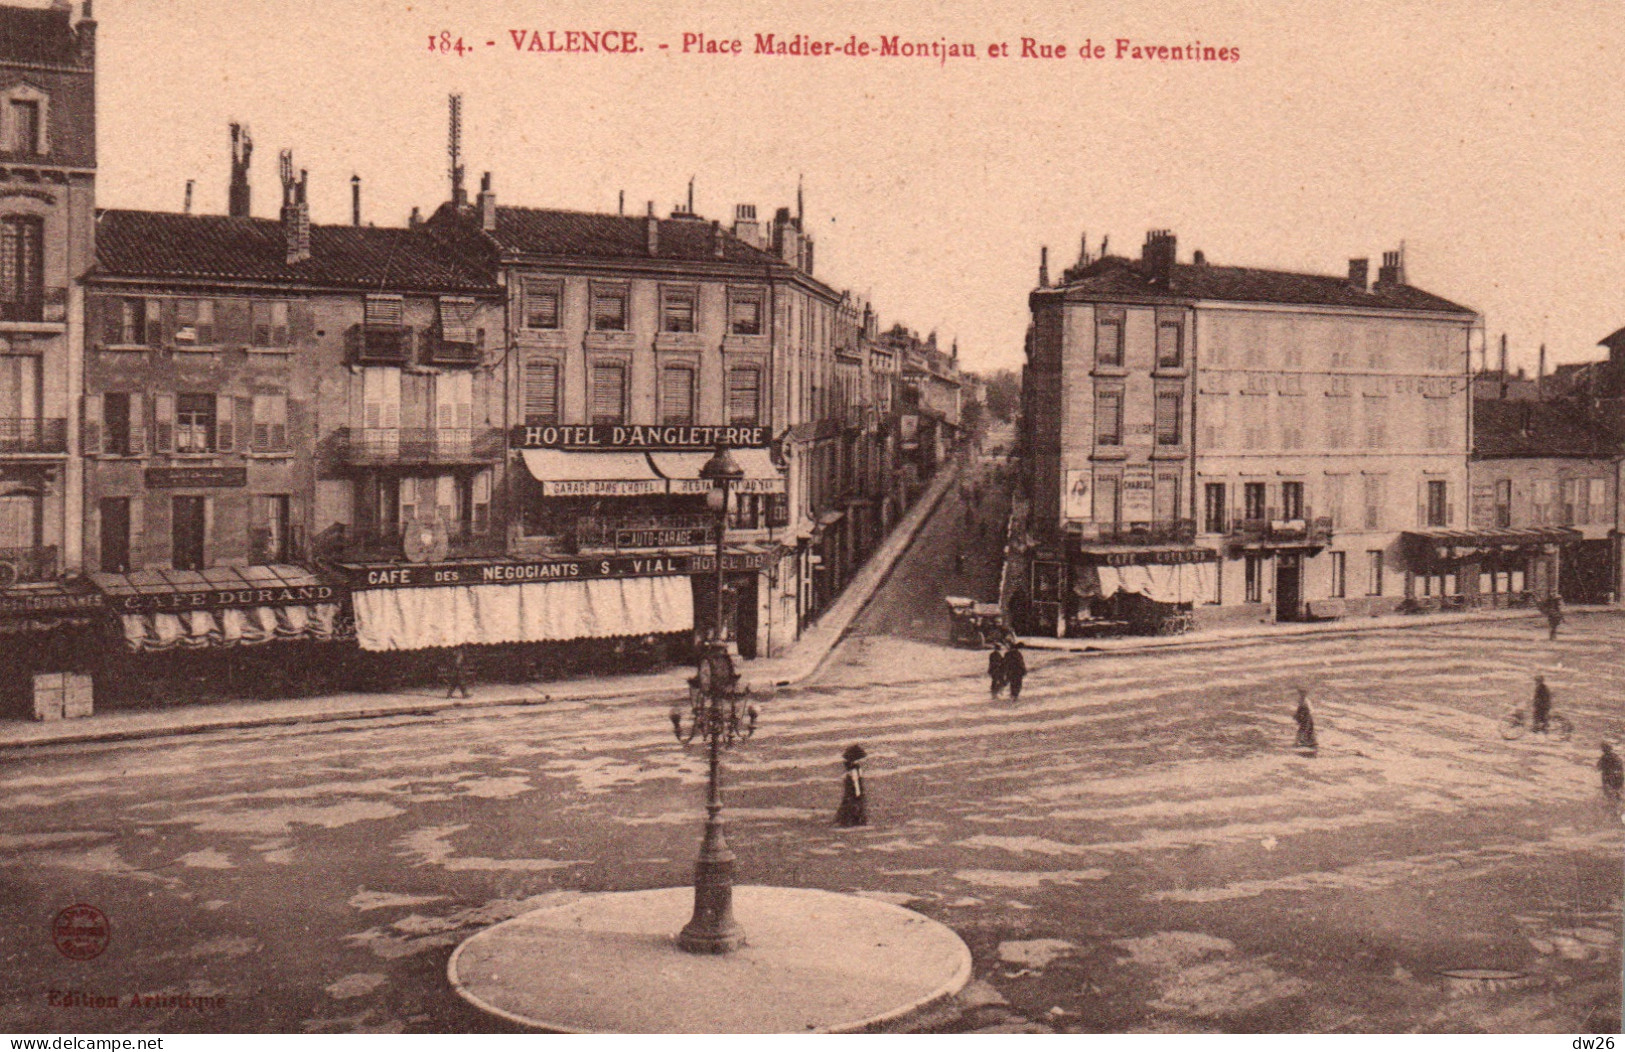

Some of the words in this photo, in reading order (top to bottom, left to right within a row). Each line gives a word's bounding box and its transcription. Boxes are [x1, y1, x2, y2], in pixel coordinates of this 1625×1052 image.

[525, 426, 600, 446] HOTEL
[612, 425, 764, 445] D'ANGLETERRE
[553, 482, 590, 494] GARAGE
[594, 482, 617, 493] DANS
[631, 530, 692, 546] AUTO-GARAGE
[434, 571, 459, 582] DES
[632, 558, 677, 573] VIAL
[218, 586, 333, 604] DURAND
